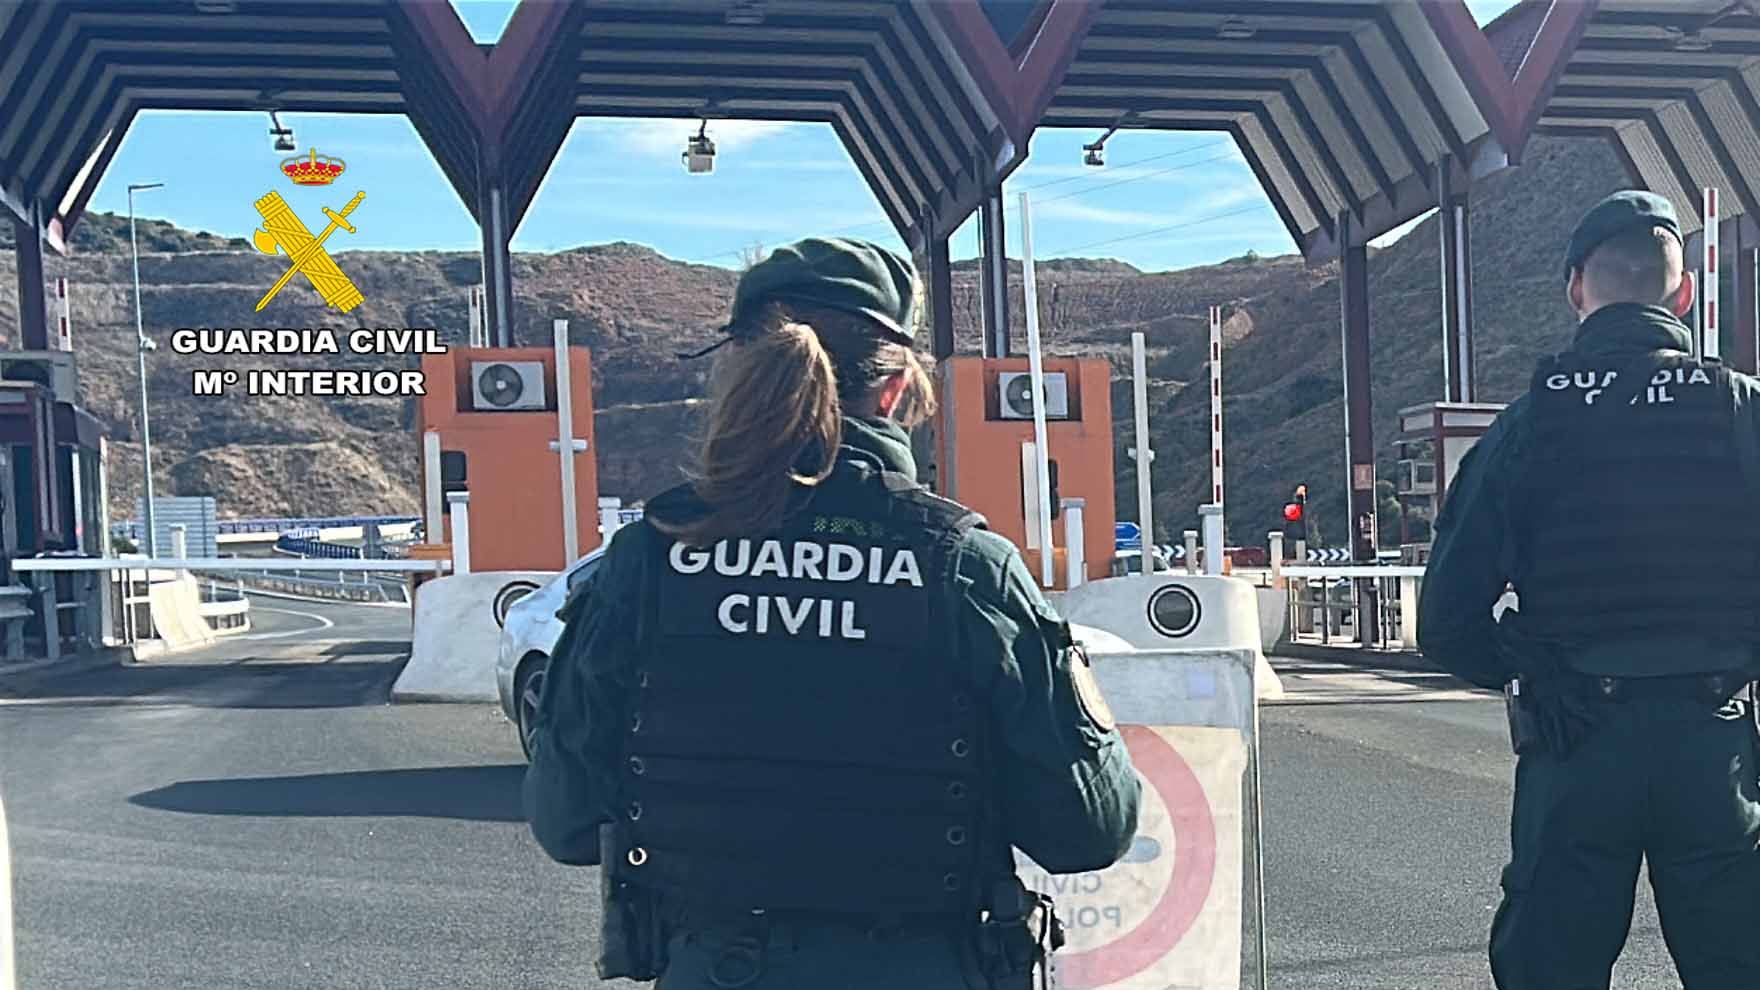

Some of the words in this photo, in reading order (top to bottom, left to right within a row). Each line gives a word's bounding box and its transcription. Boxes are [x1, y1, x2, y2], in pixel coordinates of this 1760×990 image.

[1546, 368, 1712, 390] GUADIA
[668, 538, 924, 588] GUARDIA
[716, 593, 866, 640] CIVIL
